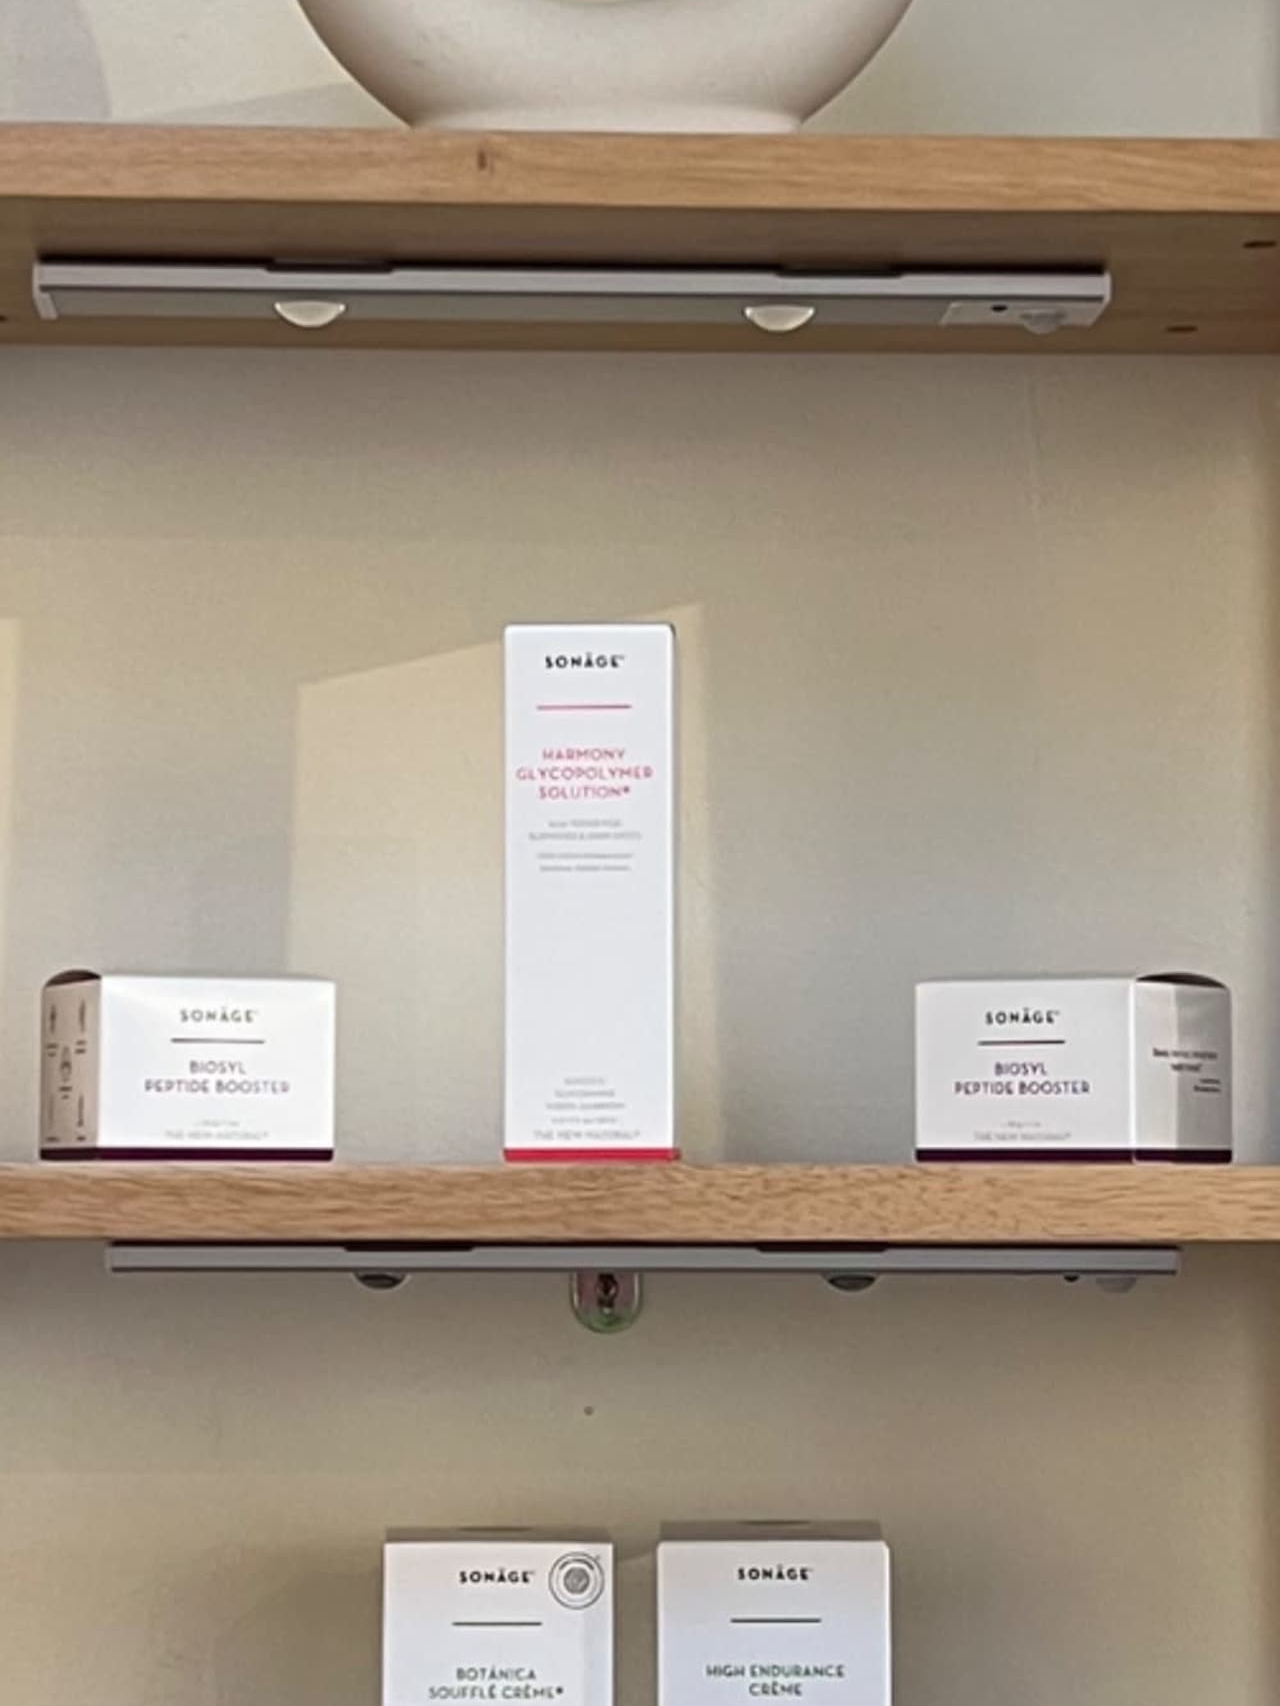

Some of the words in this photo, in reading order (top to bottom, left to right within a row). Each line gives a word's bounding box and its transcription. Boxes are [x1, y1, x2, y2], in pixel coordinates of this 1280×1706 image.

[542, 748, 625, 761] HARMONY
[516, 766, 654, 781] GLYCOPOLYMER
[189, 1060, 247, 1075] BIOSYL
[994, 1061, 1048, 1076] BIOSYL
[144, 1079, 209, 1094] PEPTIDE
[215, 1079, 290, 1094] BOOSTER
[954, 1081, 1014, 1095] PEPTIDE
[1018, 1080, 1090, 1095] BOOSTER
[705, 1665, 746, 1678] HIGH
[750, 1664, 845, 1678] ENDURANCE
